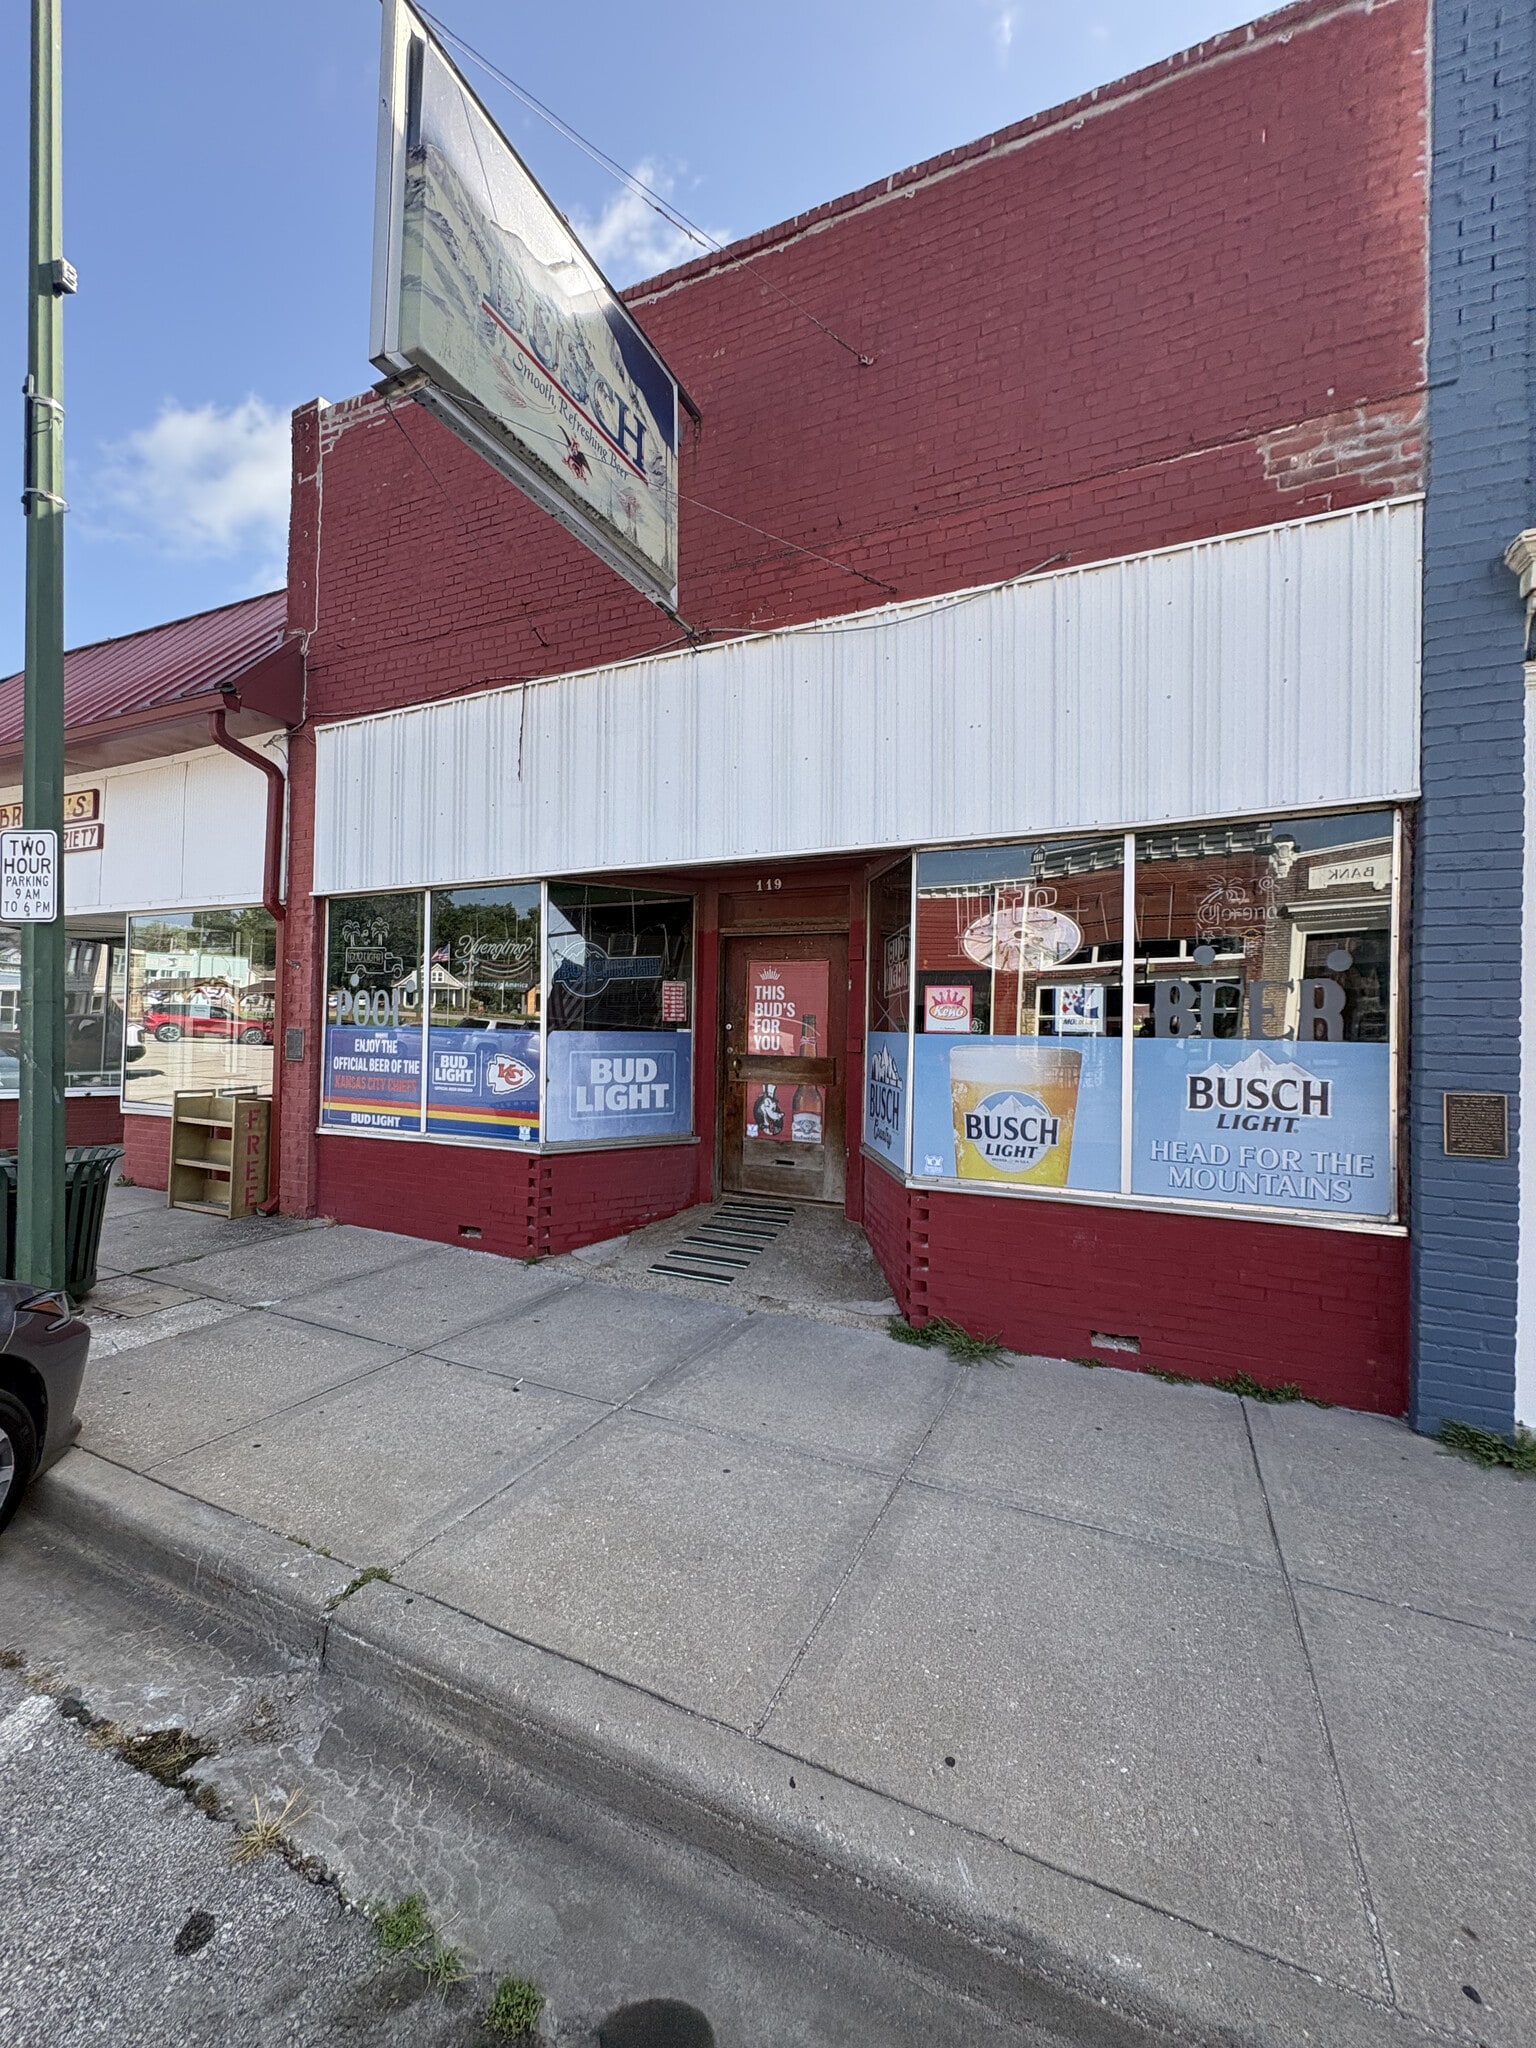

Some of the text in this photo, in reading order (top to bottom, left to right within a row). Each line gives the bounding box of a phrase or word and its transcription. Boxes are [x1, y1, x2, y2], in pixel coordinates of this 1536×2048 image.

[483, 255, 649, 475] BUSCH
[513, 353, 629, 481] Smooth, Refreshing Beer
[9, 840, 46, 856] TWO
[4, 858, 51, 874] HOUR
[5, 875, 49, 887] PARKING
[756, 878, 783, 891] 119
[15, 888, 40, 900] 9 AM
[4, 901, 50, 912] TO 6 PM
[454, 934, 534, 960] Yuengling
[754, 985, 786, 1001] THIS
[754, 1002, 796, 1018] BUD'S
[1154, 977, 1347, 1041] BEER
[753, 1018, 781, 1034] FOR
[354, 1038, 398, 1054] ENJOY THE
[753, 1034, 781, 1051] YOU
[333, 1056, 420, 1074] OFFICIAL BEER OF THE
[440, 1055, 468, 1068] BUD
[435, 1068, 473, 1083] LIGHT
[498, 1063, 523, 1086] KC
[590, 1058, 658, 1084] BUD
[335, 1075, 416, 1094] KANSAS CITY CHIEFS
[576, 1083, 670, 1112] LIGHT
[1188, 1075, 1331, 1116] BUSCH
[869, 1083, 900, 1131] BUSCH
[350, 1112, 401, 1127] BUD LIGHT
[1216, 1113, 1300, 1133] LIGHT
[965, 1113, 1059, 1145] BUSCH
[244, 1109, 262, 1206] FREE
[985, 1143, 1038, 1158] LIGHT
[1150, 1139, 1375, 1178] HEAD FOR THE
[1168, 1166, 1352, 1203] MOUNTAINS
